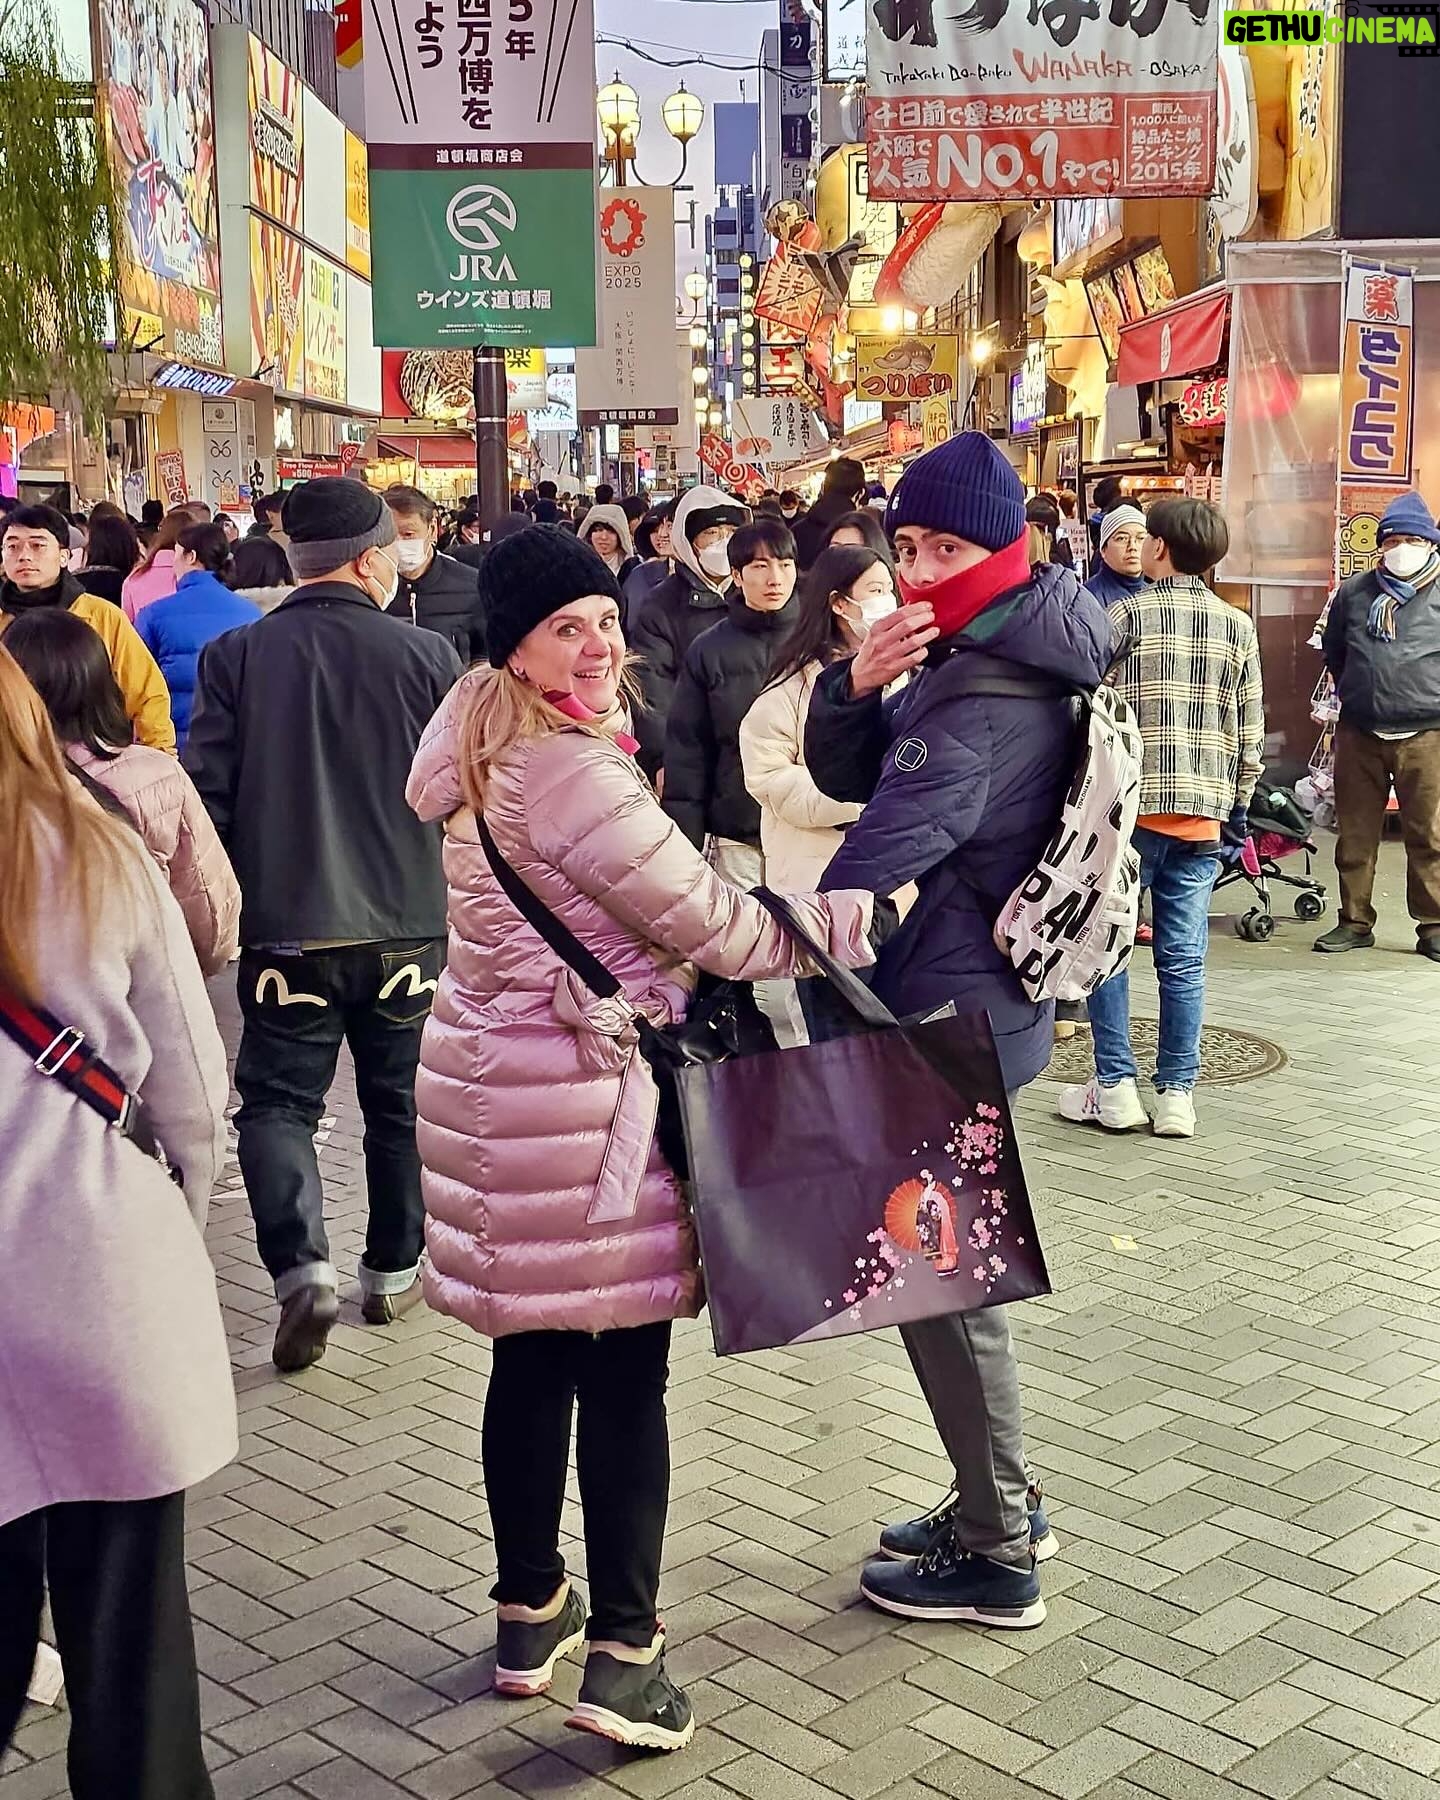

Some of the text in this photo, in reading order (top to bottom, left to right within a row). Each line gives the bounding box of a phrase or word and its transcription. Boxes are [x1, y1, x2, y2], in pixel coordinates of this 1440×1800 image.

[414, 1, 444, 69] よう
[873, 97, 1113, 128] 千日前で愛されて半世紀
[436, 149, 523, 164] 道頓堀商店会
[873, 134, 932, 158] 大阪で
[1131, 143, 1204, 160] ランキング
[937, 130, 1058, 188] No.1
[872, 157, 931, 188] 人気
[1131, 161, 1202, 180] 2015年
[450, 253, 518, 281] JRA
[605, 265, 641, 277] EXPO
[606, 277, 641, 289] 2025
[417, 289, 552, 310] ウインズ道頓堀
[861, 373, 952, 398] つりぼり
[1011, 902, 1026, 922] TOKYO
[1074, 922, 1090, 944] KYOTO
